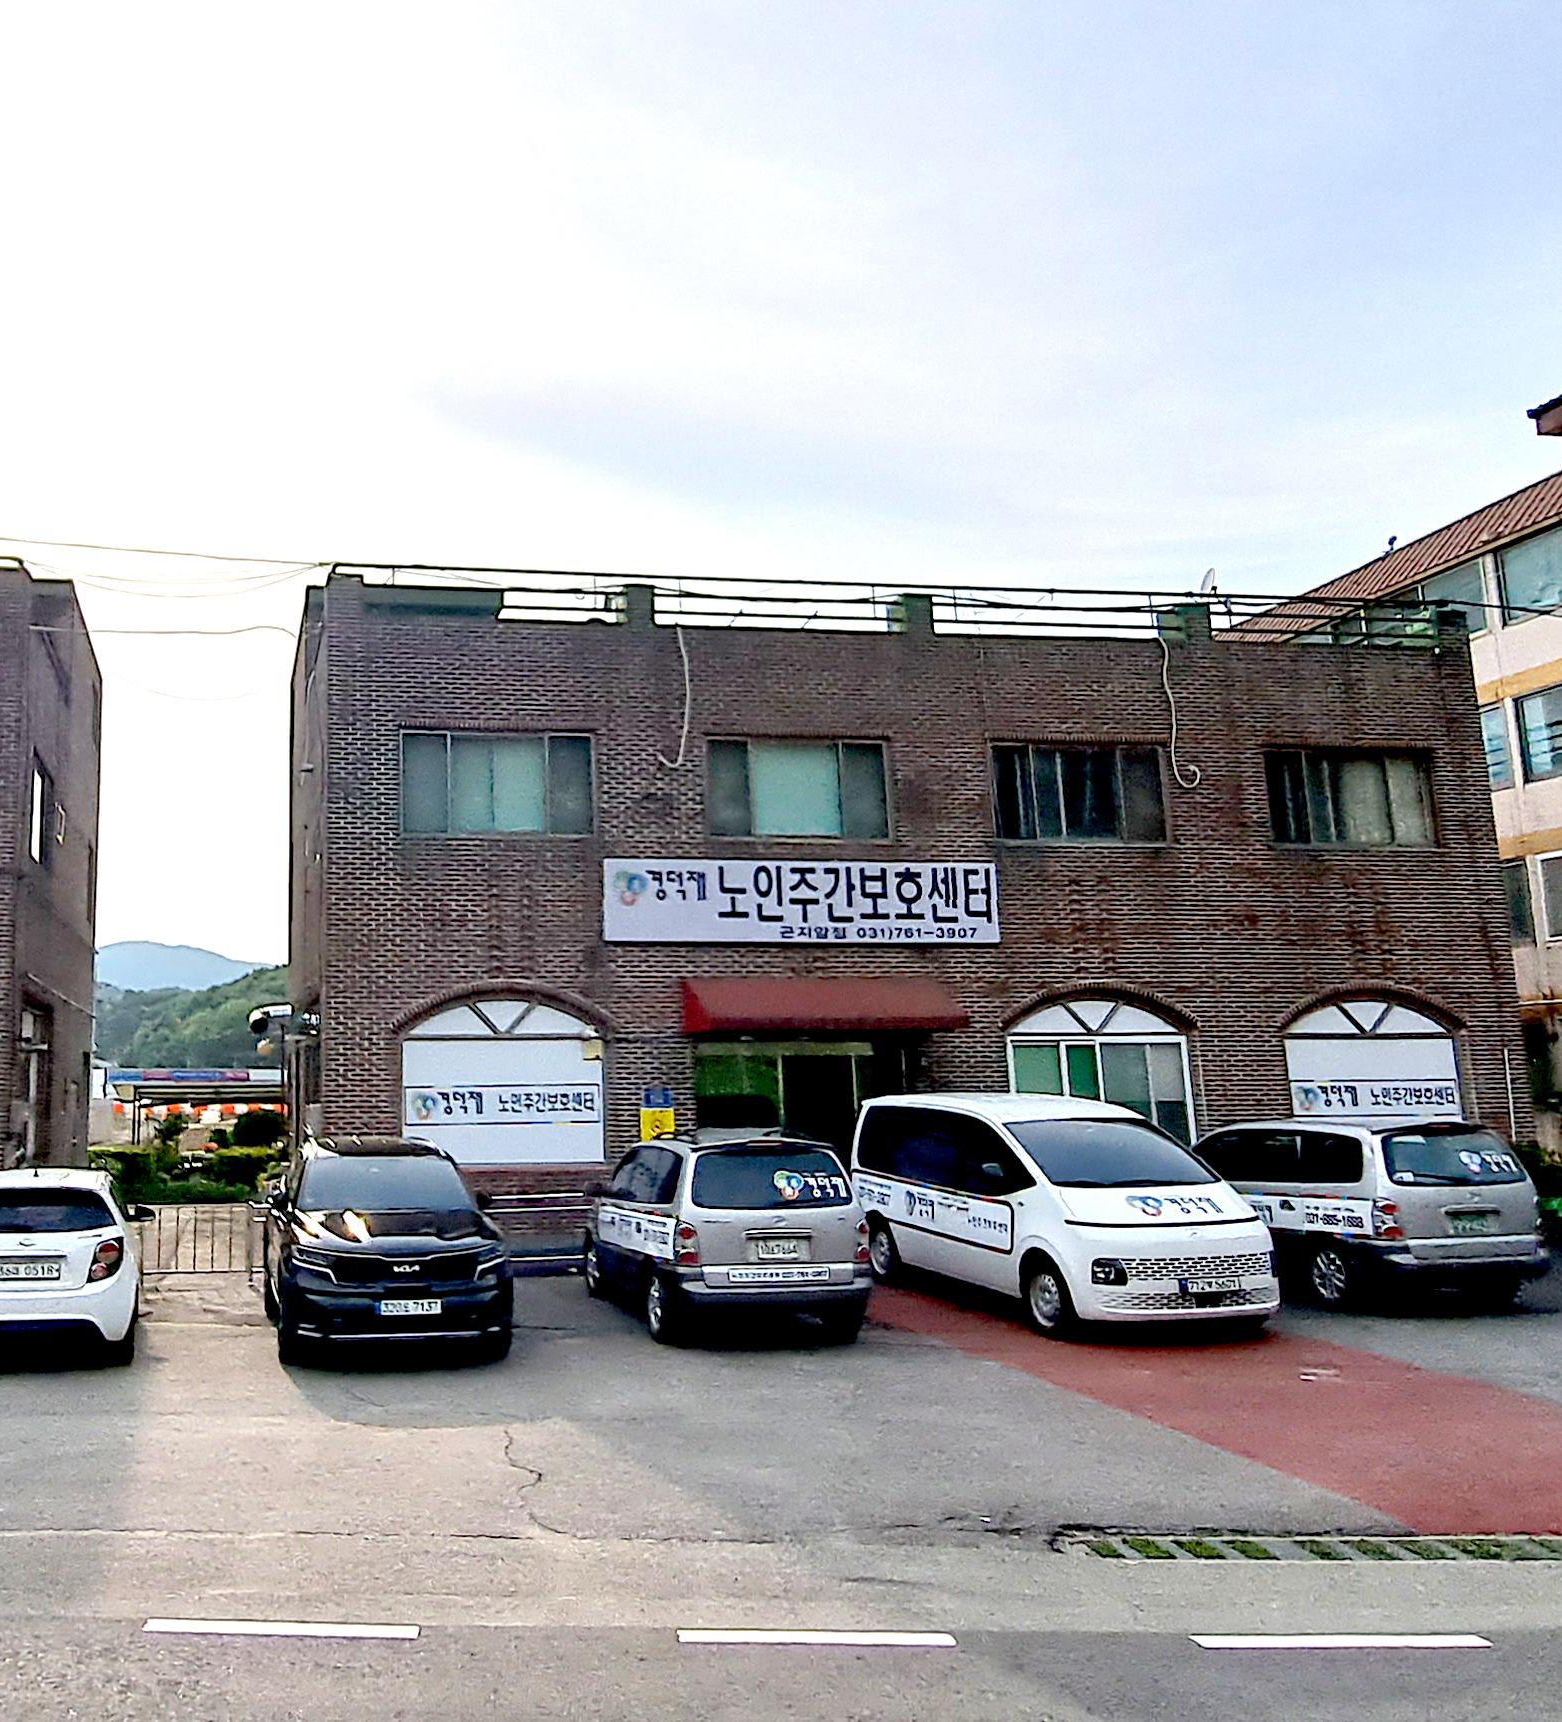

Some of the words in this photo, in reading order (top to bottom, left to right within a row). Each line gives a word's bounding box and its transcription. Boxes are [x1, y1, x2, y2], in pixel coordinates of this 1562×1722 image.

[646, 869, 706, 901] 경덕재
[717, 865, 993, 924] 노인주간보호센터
[856, 927, 978, 940] 031)761-3907
[437, 1091, 484, 1116] 경덕재
[498, 1092, 595, 1114] 노인주간보호센터
[1317, 1086, 1359, 1107] 경덕재
[804, 1176, 848, 1198] 경덕재
